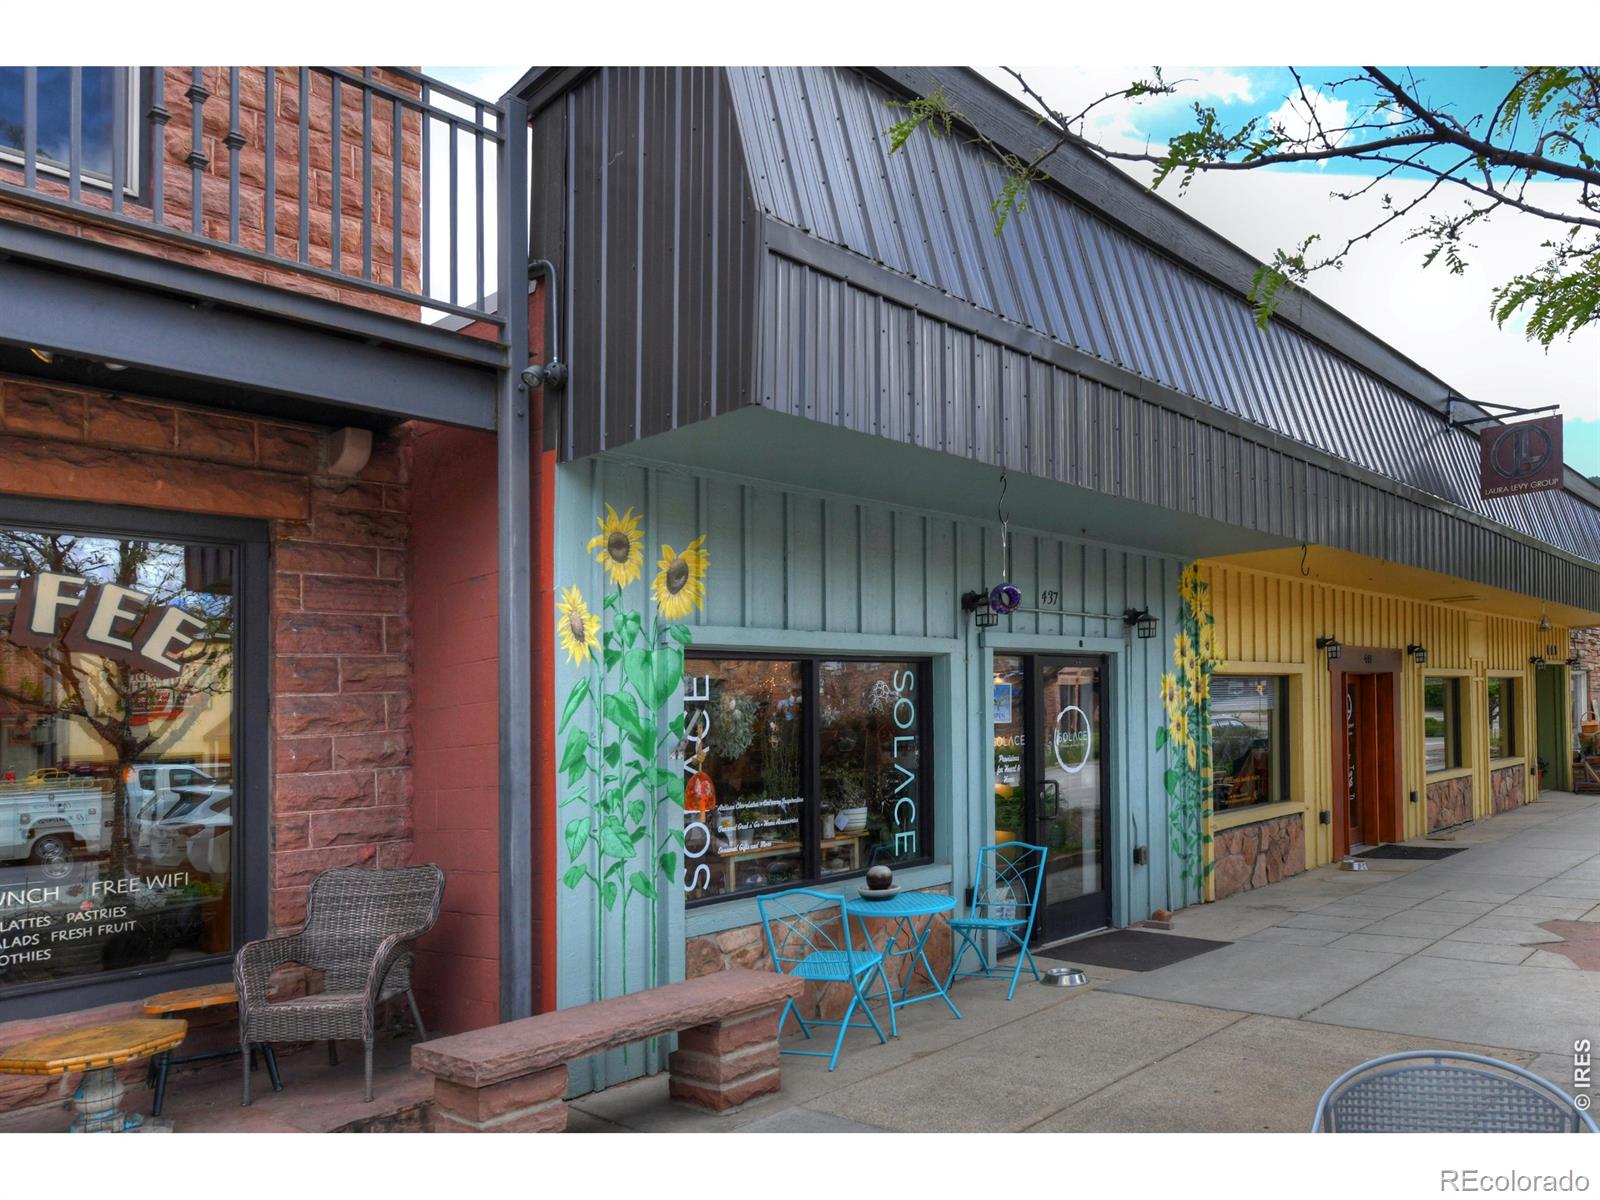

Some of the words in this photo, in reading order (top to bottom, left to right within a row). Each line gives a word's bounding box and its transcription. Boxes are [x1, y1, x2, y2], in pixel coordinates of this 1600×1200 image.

[1484, 486, 1509, 496] LAURA
[1510, 483, 1530, 492] LEVY
[1530, 478, 1559, 489] GROUP
[1041, 590, 1059, 606] 437
[893, 670, 916, 857] SOLACE
[92, 877, 141, 896] FREE
[146, 871, 189, 890] WIFI
[0, 915, 51, 933] LATTES
[66, 906, 127, 924] PASTRIES
[51, 926, 93, 942] FRESH
[97, 920, 137, 935] FRUIT
